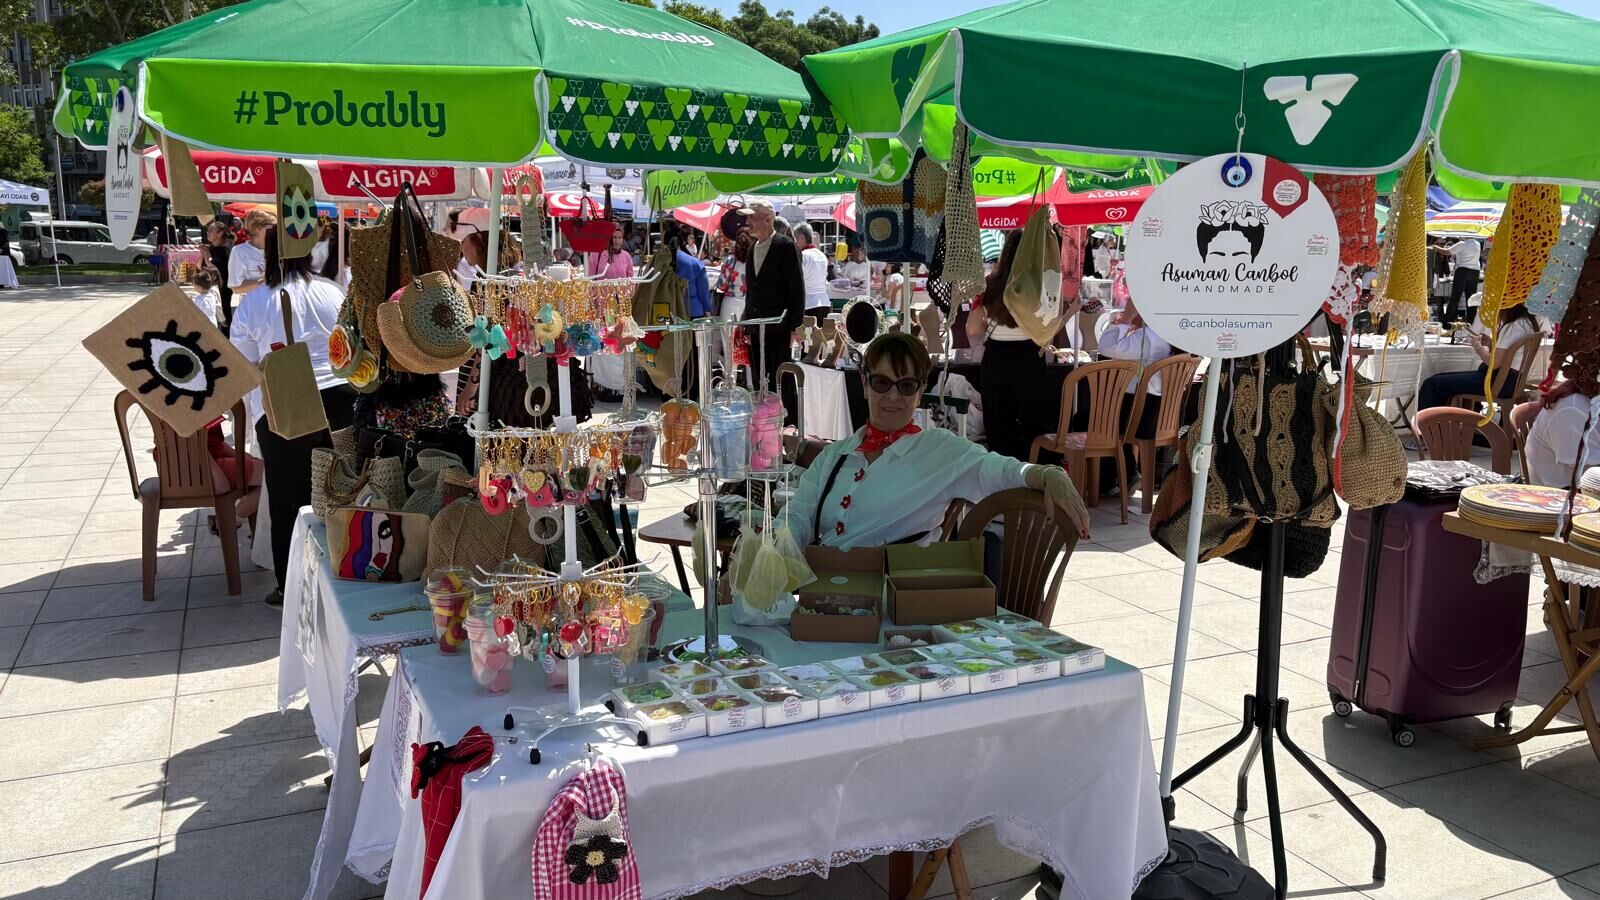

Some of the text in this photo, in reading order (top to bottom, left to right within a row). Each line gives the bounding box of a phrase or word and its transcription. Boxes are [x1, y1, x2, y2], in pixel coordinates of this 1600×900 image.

[566, 16, 715, 47] #Probably
[233, 89, 446, 137] #Probably
[1161, 262, 1299, 283] Asuman Canbol
[1181, 285, 1276, 294] HANDMADE
[1178, 318, 1273, 330] @canbolasuman
